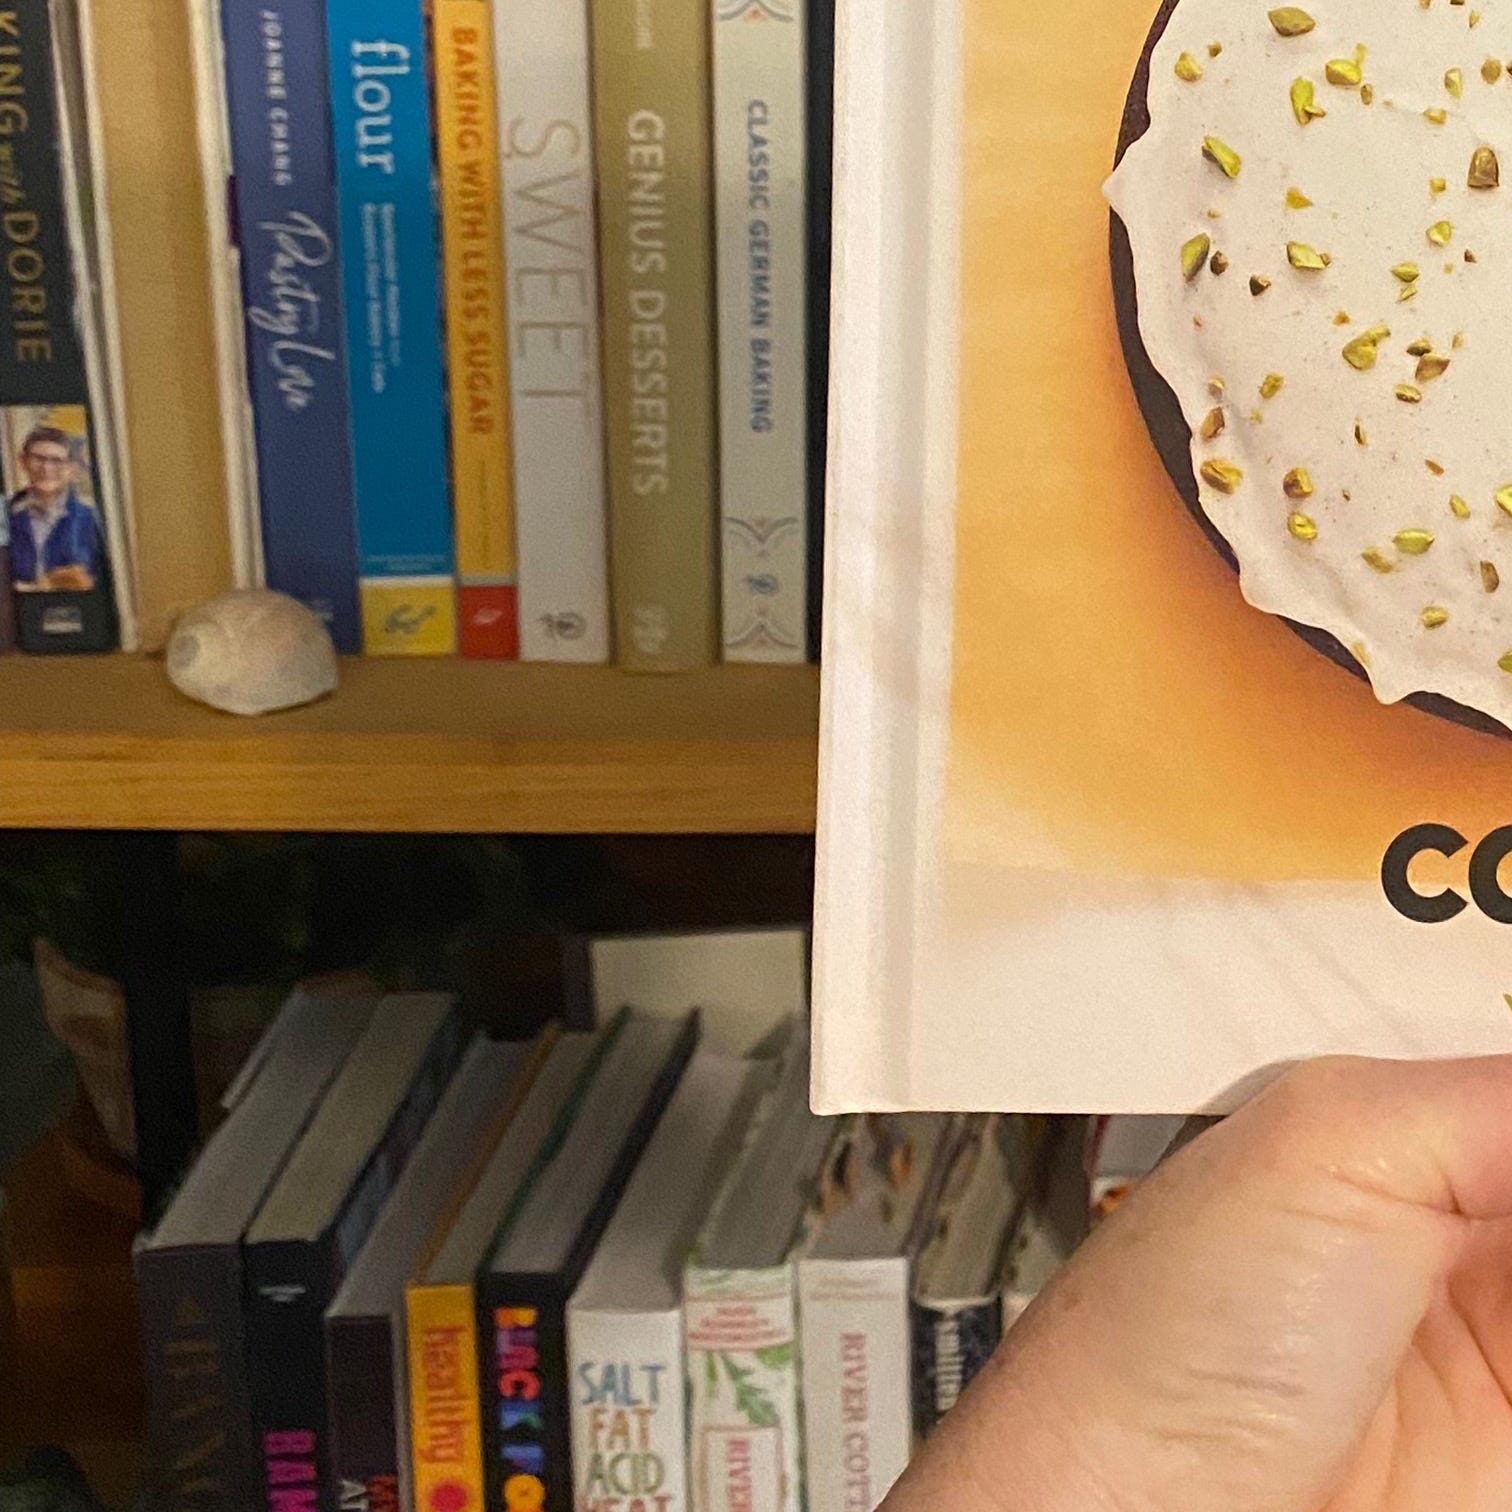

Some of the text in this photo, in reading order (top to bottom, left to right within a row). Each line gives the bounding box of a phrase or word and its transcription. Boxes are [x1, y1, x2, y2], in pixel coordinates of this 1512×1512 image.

[260, 9, 292, 187] JOANNE CHANG
[349, 38, 411, 175] flour
[2, 210, 53, 364] DORIE
[453, 27, 495, 436] BAKING WITH LESS SUGAR
[504, 116, 594, 424] SWEET
[625, 107, 669, 497] GENIUS DESSERTS
[747, 98, 775, 433] CLASSIC GERMAN BAKING
[495, 1306, 542, 1431] BLACK
[578, 1361, 667, 1406] SALT
[586, 1406, 658, 1452] FAT
[841, 1332, 868, 1424] RIVER
[586, 1452, 666, 1496] ACID
